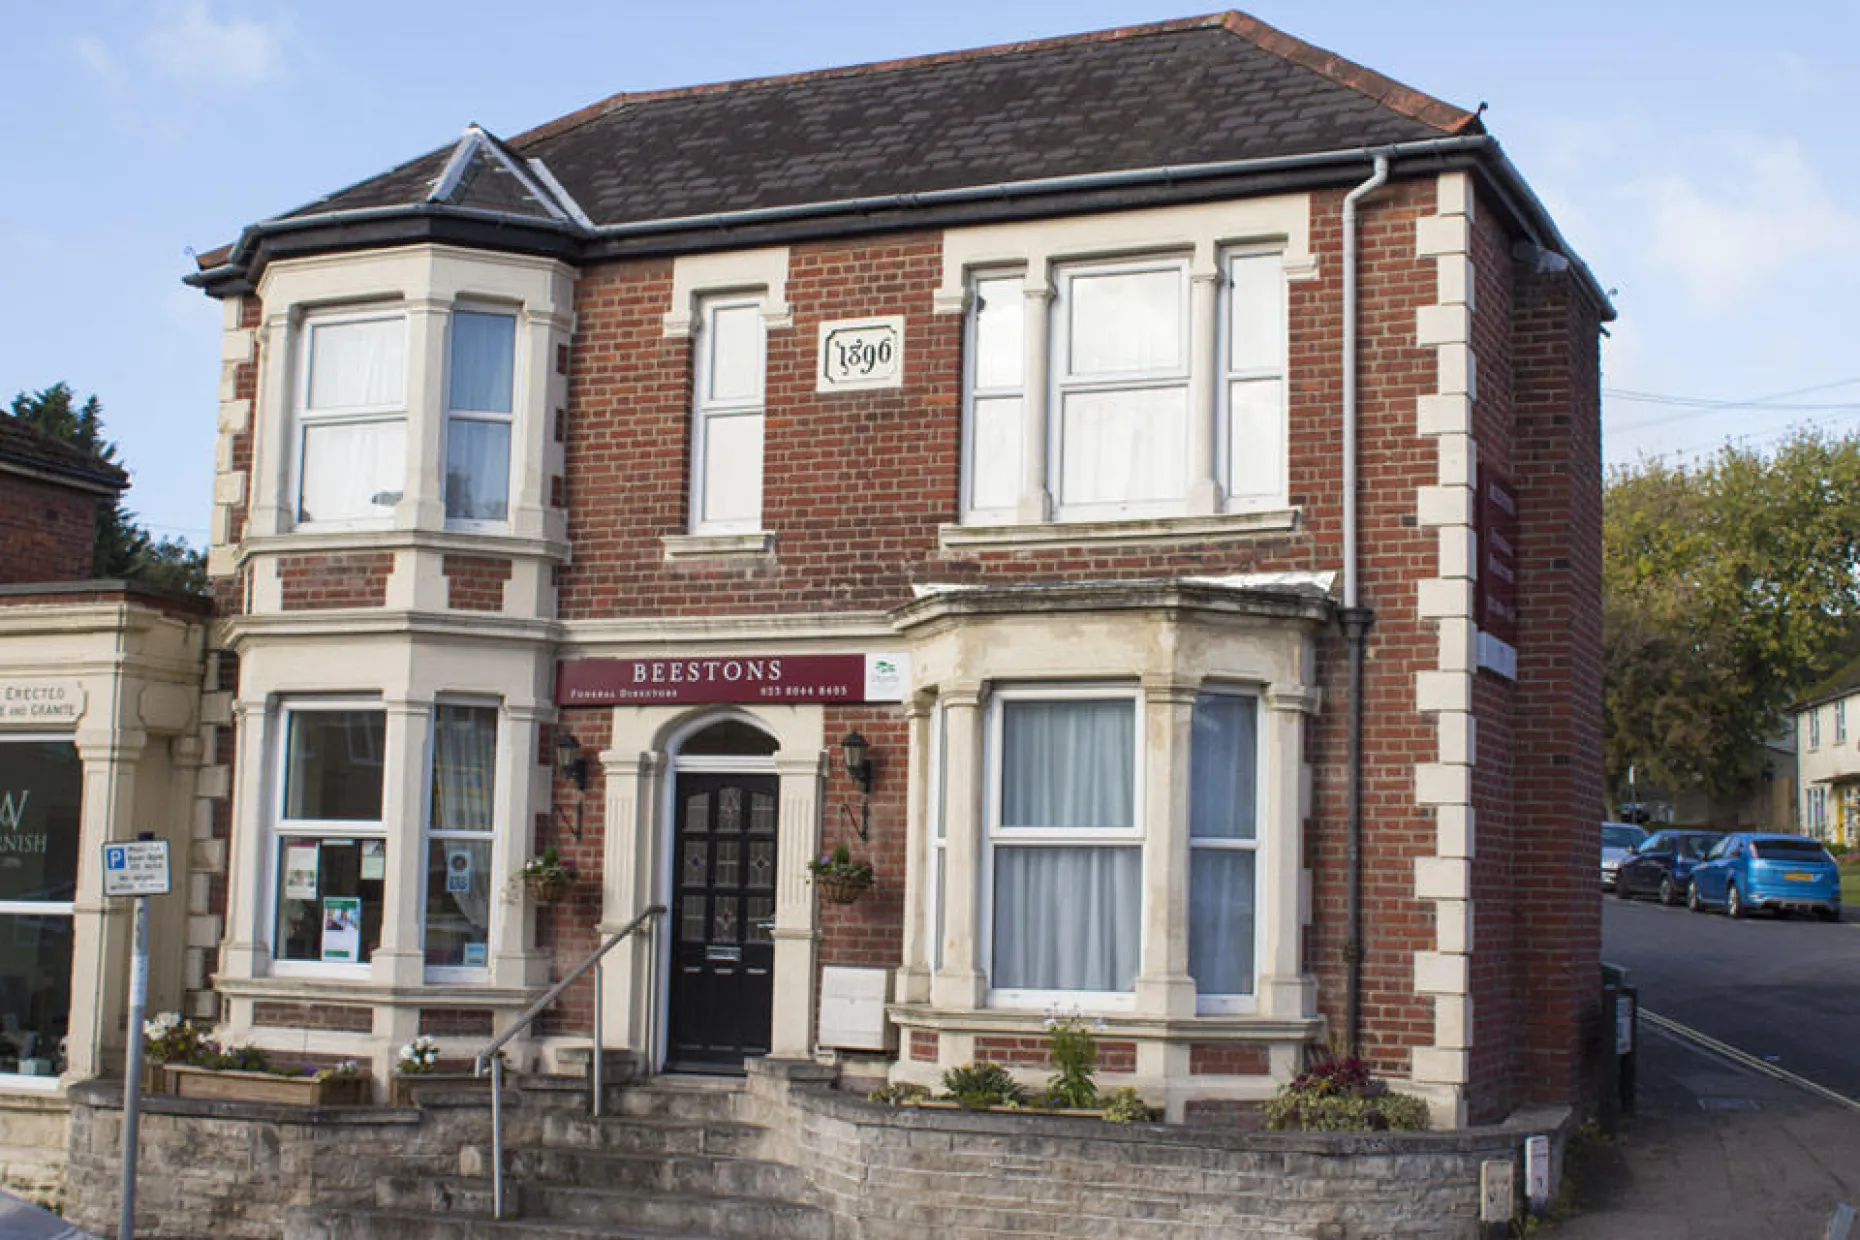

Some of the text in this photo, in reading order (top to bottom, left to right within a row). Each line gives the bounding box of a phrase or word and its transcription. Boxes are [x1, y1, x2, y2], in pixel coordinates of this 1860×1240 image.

[835, 338, 892, 376] 1896
[632, 659, 782, 683] BEESTONS
[110, 851, 121, 867] P
